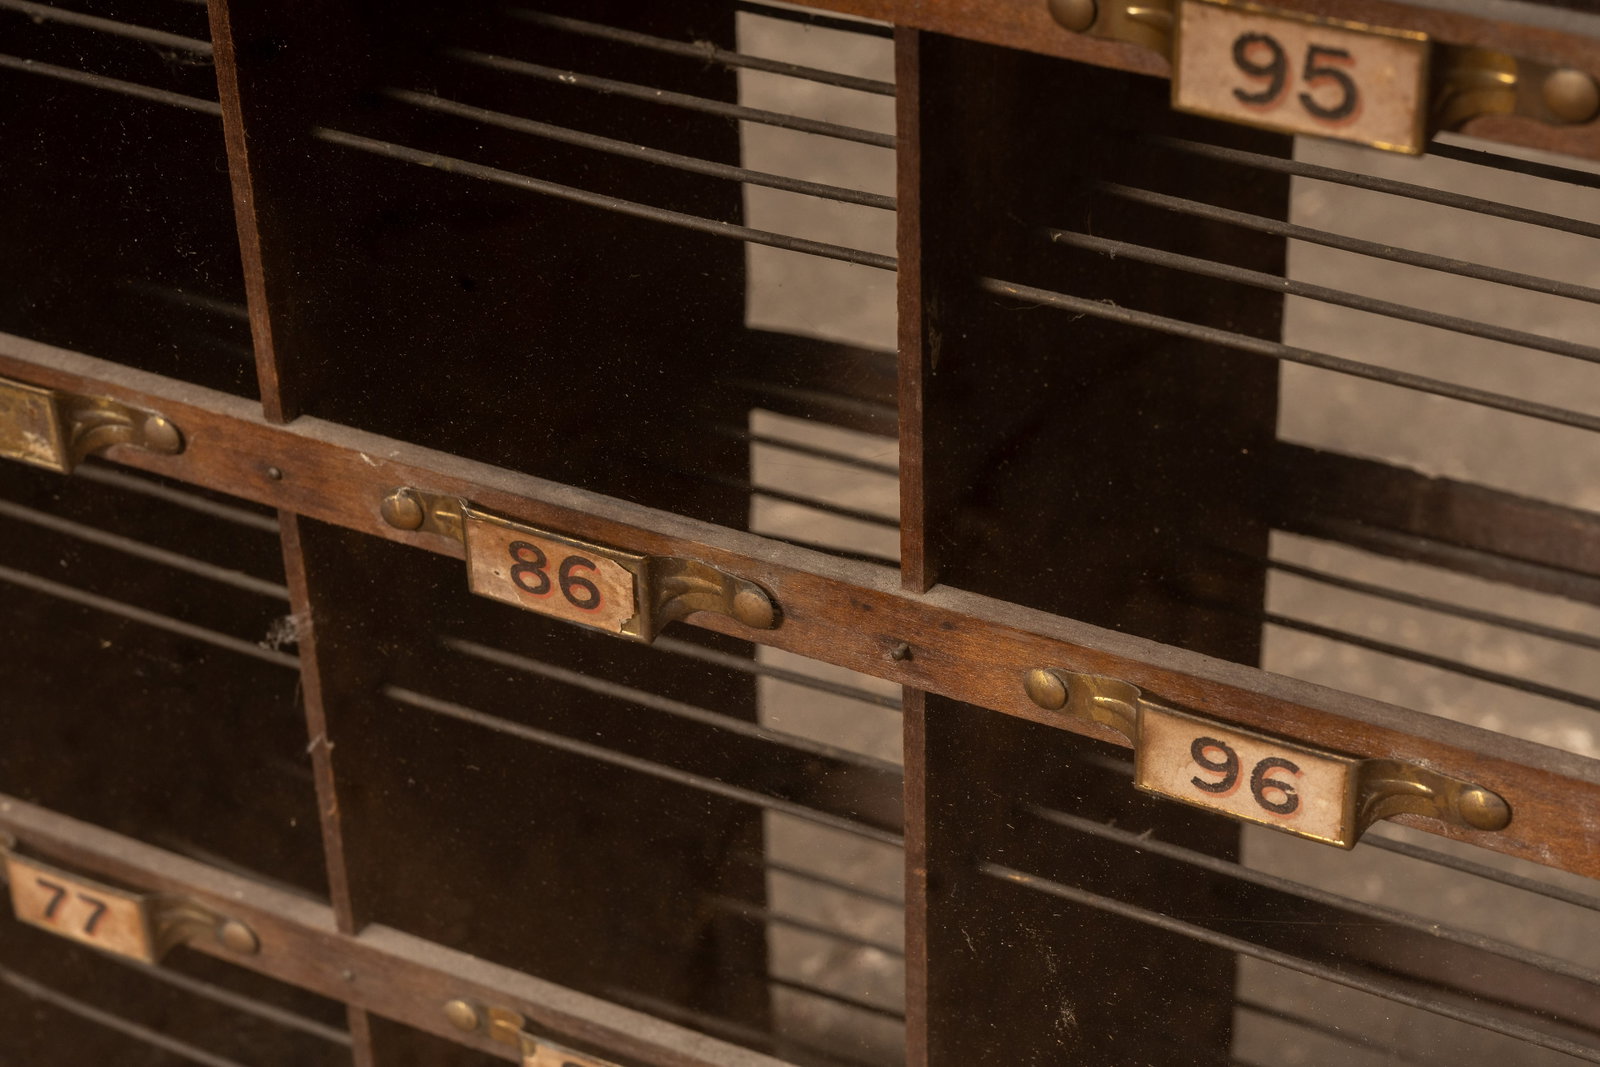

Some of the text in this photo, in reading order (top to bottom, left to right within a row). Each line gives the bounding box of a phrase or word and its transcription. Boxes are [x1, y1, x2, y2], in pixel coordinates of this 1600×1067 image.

[1231, 31, 1361, 125] 95
[508, 540, 603, 612] 86
[1190, 736, 1302, 816] 96
[35, 877, 109, 936] 77
